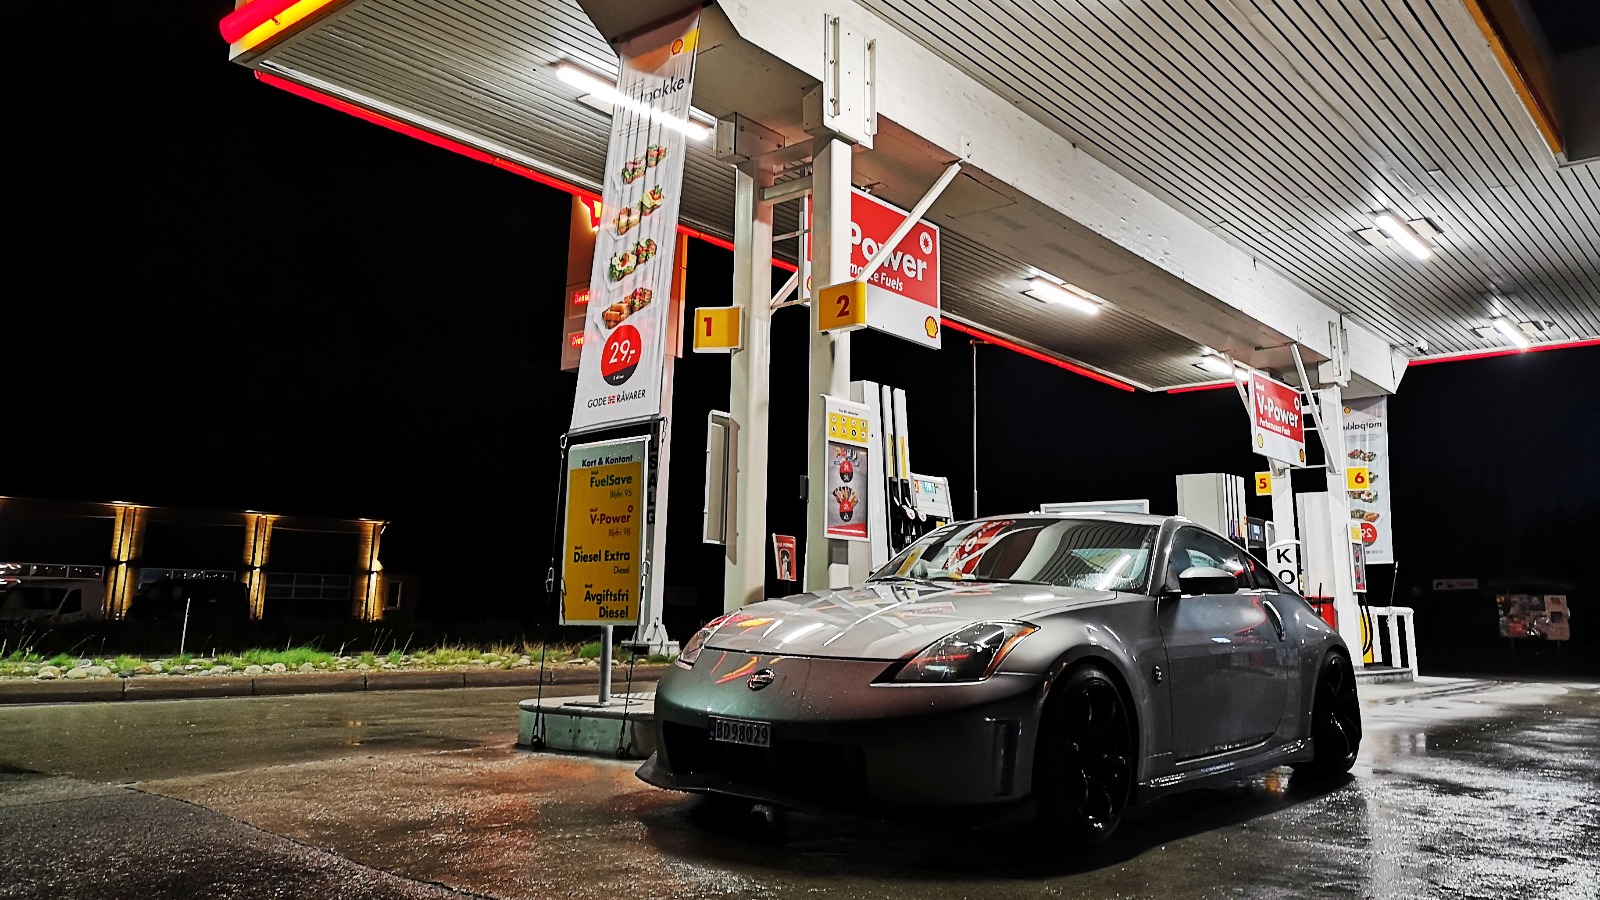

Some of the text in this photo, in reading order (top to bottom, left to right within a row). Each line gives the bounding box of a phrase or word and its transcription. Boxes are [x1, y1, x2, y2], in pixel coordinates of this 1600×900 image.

[881, 272, 904, 292] Fuels
[836, 294, 850, 318] 2
[703, 317, 713, 337] 1
[609, 339, 636, 364] 29,-
[587, 388, 646, 409] GODE RÅVARER
[1256, 392, 1299, 429] V-Power
[1260, 417, 1291, 437] Performance Fuels
[582, 454, 633, 468] Kort & Kontant
[590, 474, 633, 488] FuelSave
[1259, 478, 1268, 489] 5
[1354, 472, 1365, 484] 6
[624, 488, 632, 497] 95
[589, 513, 631, 525] V-Power
[623, 528, 631, 536] 98
[573, 549, 630, 563] Diesel Extra
[613, 566, 630, 575] Diesel
[584, 589, 629, 605] Avgiftsfri
[598, 605, 629, 619] Diesel
